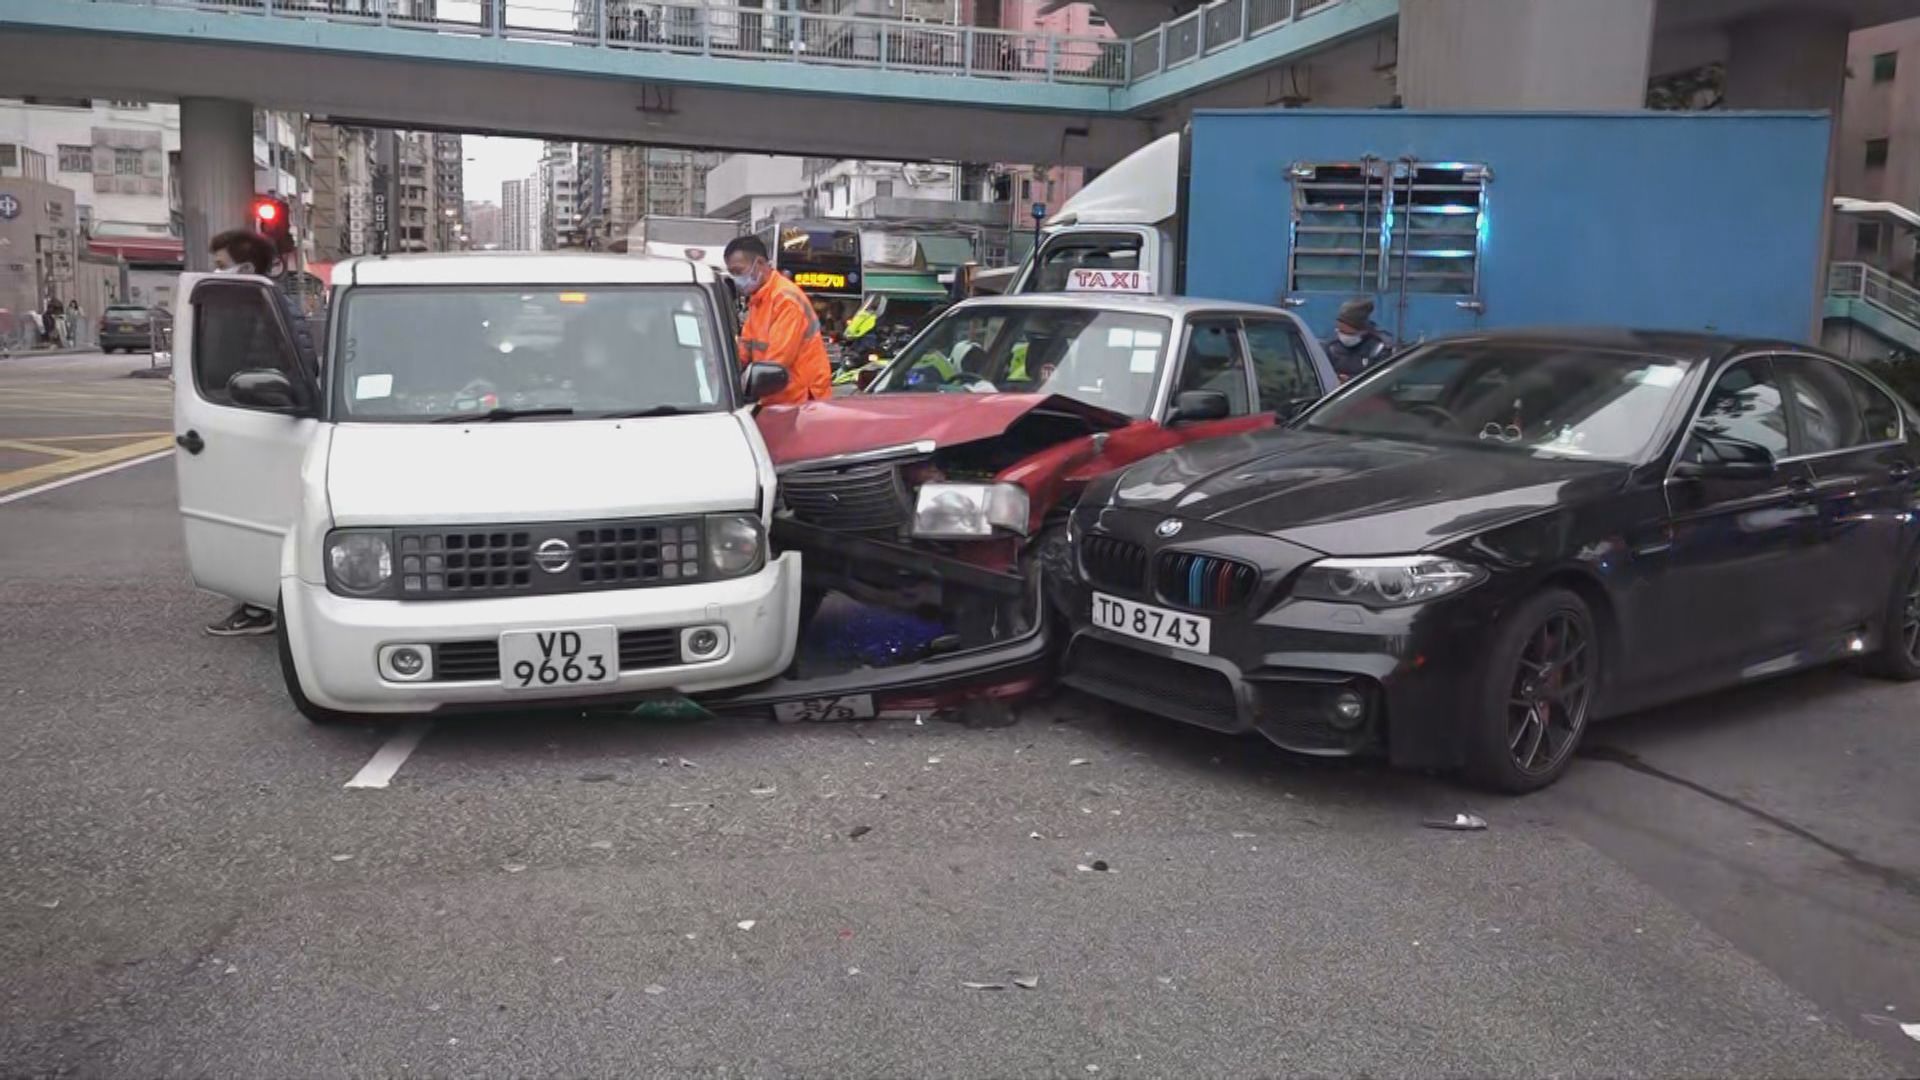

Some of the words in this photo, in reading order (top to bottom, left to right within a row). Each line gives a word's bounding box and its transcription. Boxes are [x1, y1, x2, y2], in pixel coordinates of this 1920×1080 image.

[1075, 271, 1140, 289] TAXI
[1099, 597, 1125, 628] TD
[1133, 608, 1201, 647] 8743
[537, 630, 582, 657] VD
[513, 653, 607, 687] 9663
